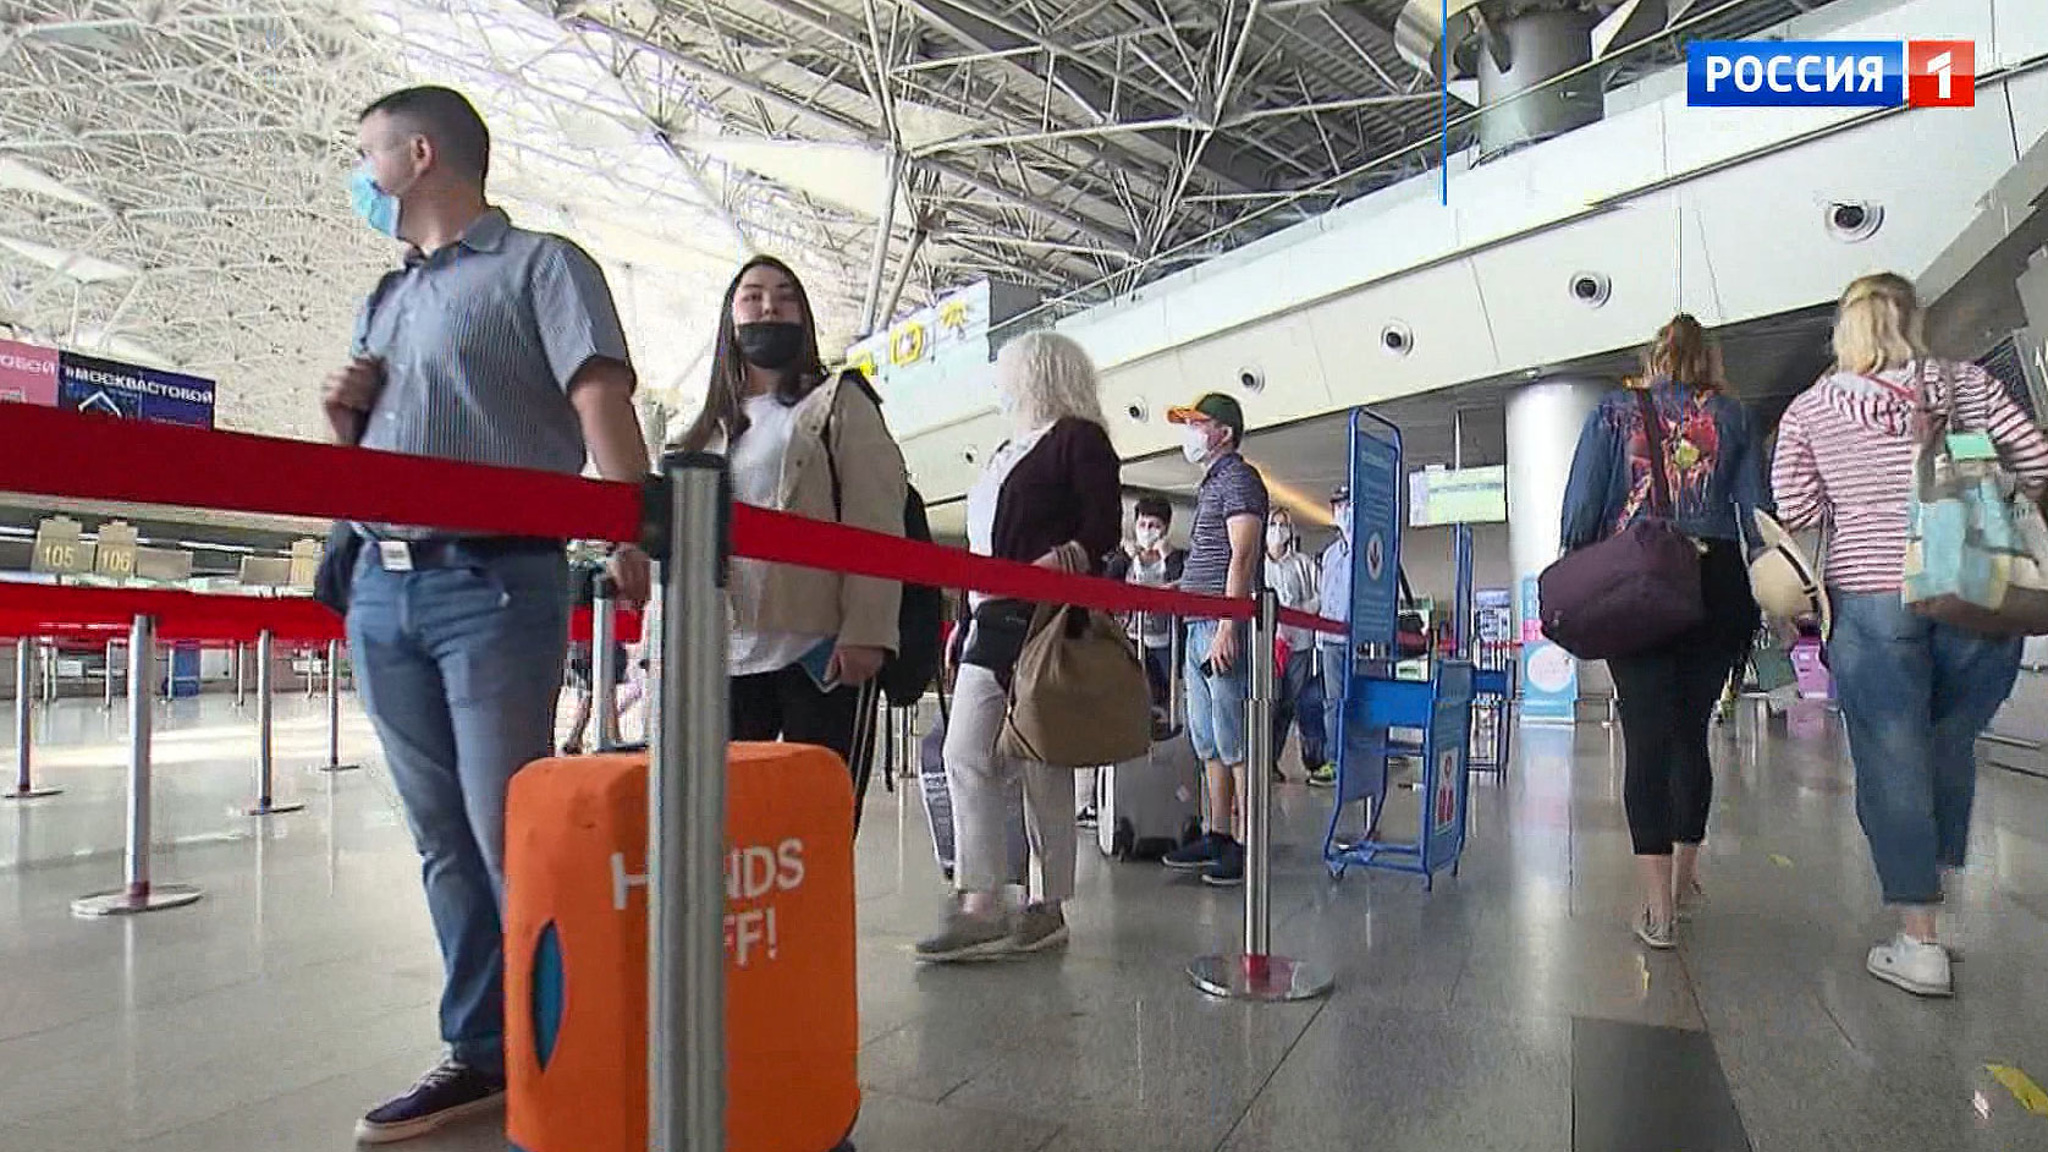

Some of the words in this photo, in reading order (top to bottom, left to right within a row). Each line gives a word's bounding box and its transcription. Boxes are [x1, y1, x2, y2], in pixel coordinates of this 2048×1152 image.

[45, 543, 75, 568] 105
[103, 550, 132, 572] 106
[610, 837, 806, 910] HNDS
